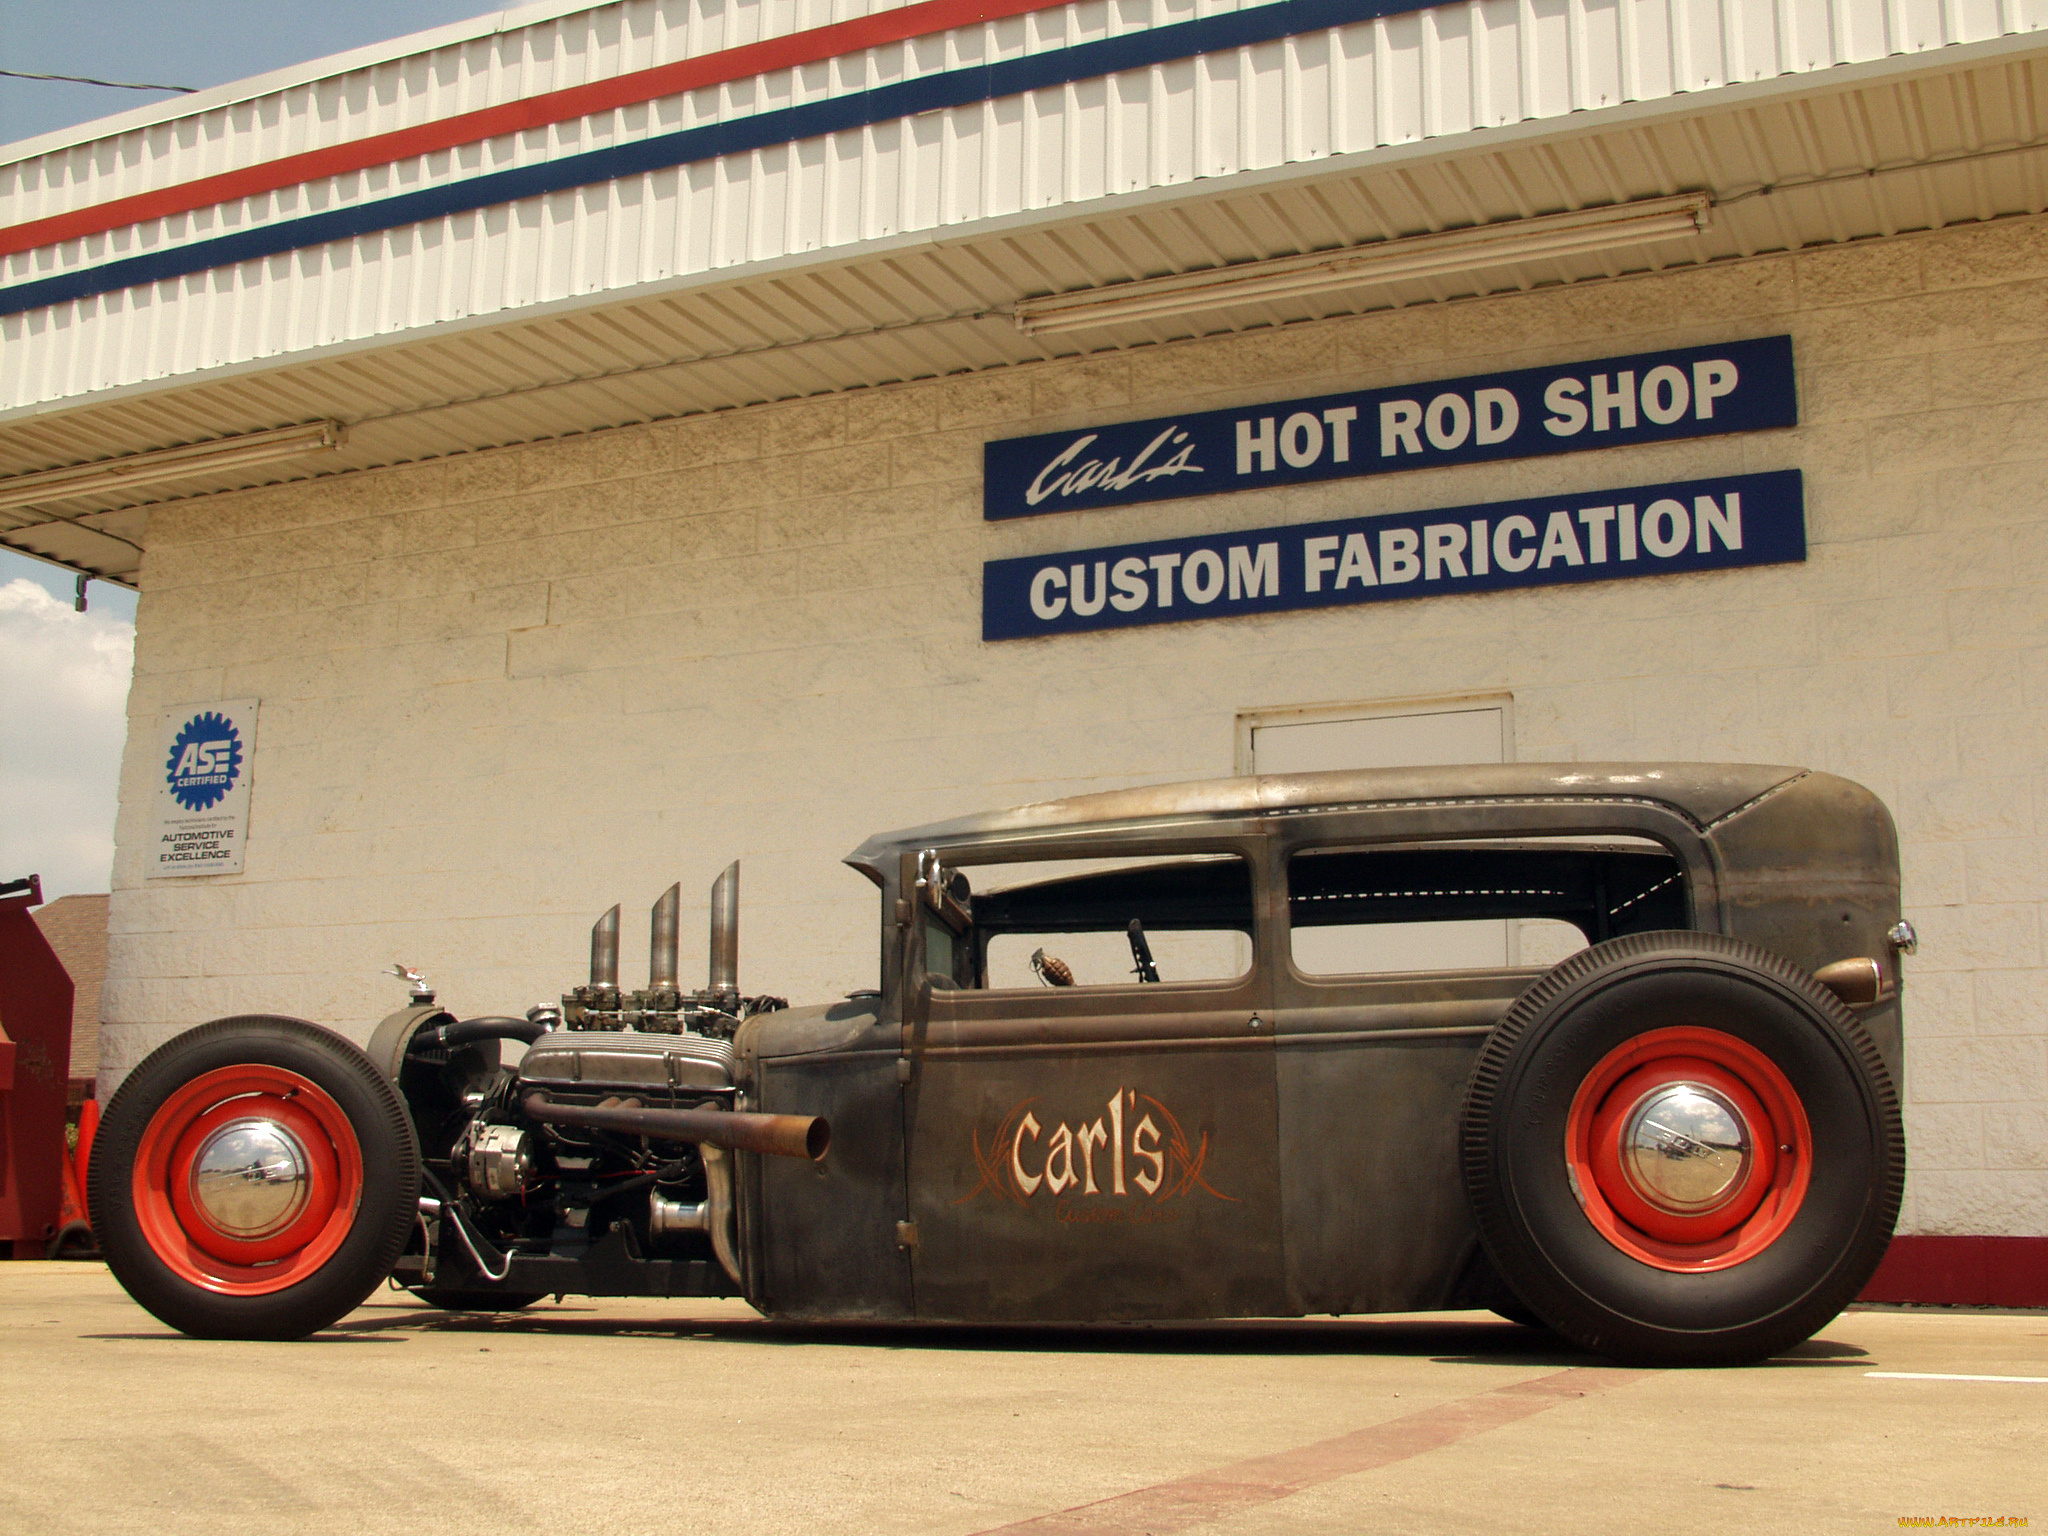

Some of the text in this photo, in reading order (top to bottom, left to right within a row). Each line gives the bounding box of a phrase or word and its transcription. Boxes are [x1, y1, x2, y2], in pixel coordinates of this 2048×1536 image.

[1025, 358, 1739, 506] Carl's HOT ROD SHOP
[1029, 492, 1744, 621] CUSTOM FABRICATION
[175, 740, 231, 776] ASE
[178, 775, 227, 787] CERTIFIED
[162, 830, 233, 842] AUTOMOTIVE
[173, 840, 220, 851] SERVICE
[160, 849, 231, 862] EXCELLENCE
[1013, 1085, 1164, 1196] Carl's
